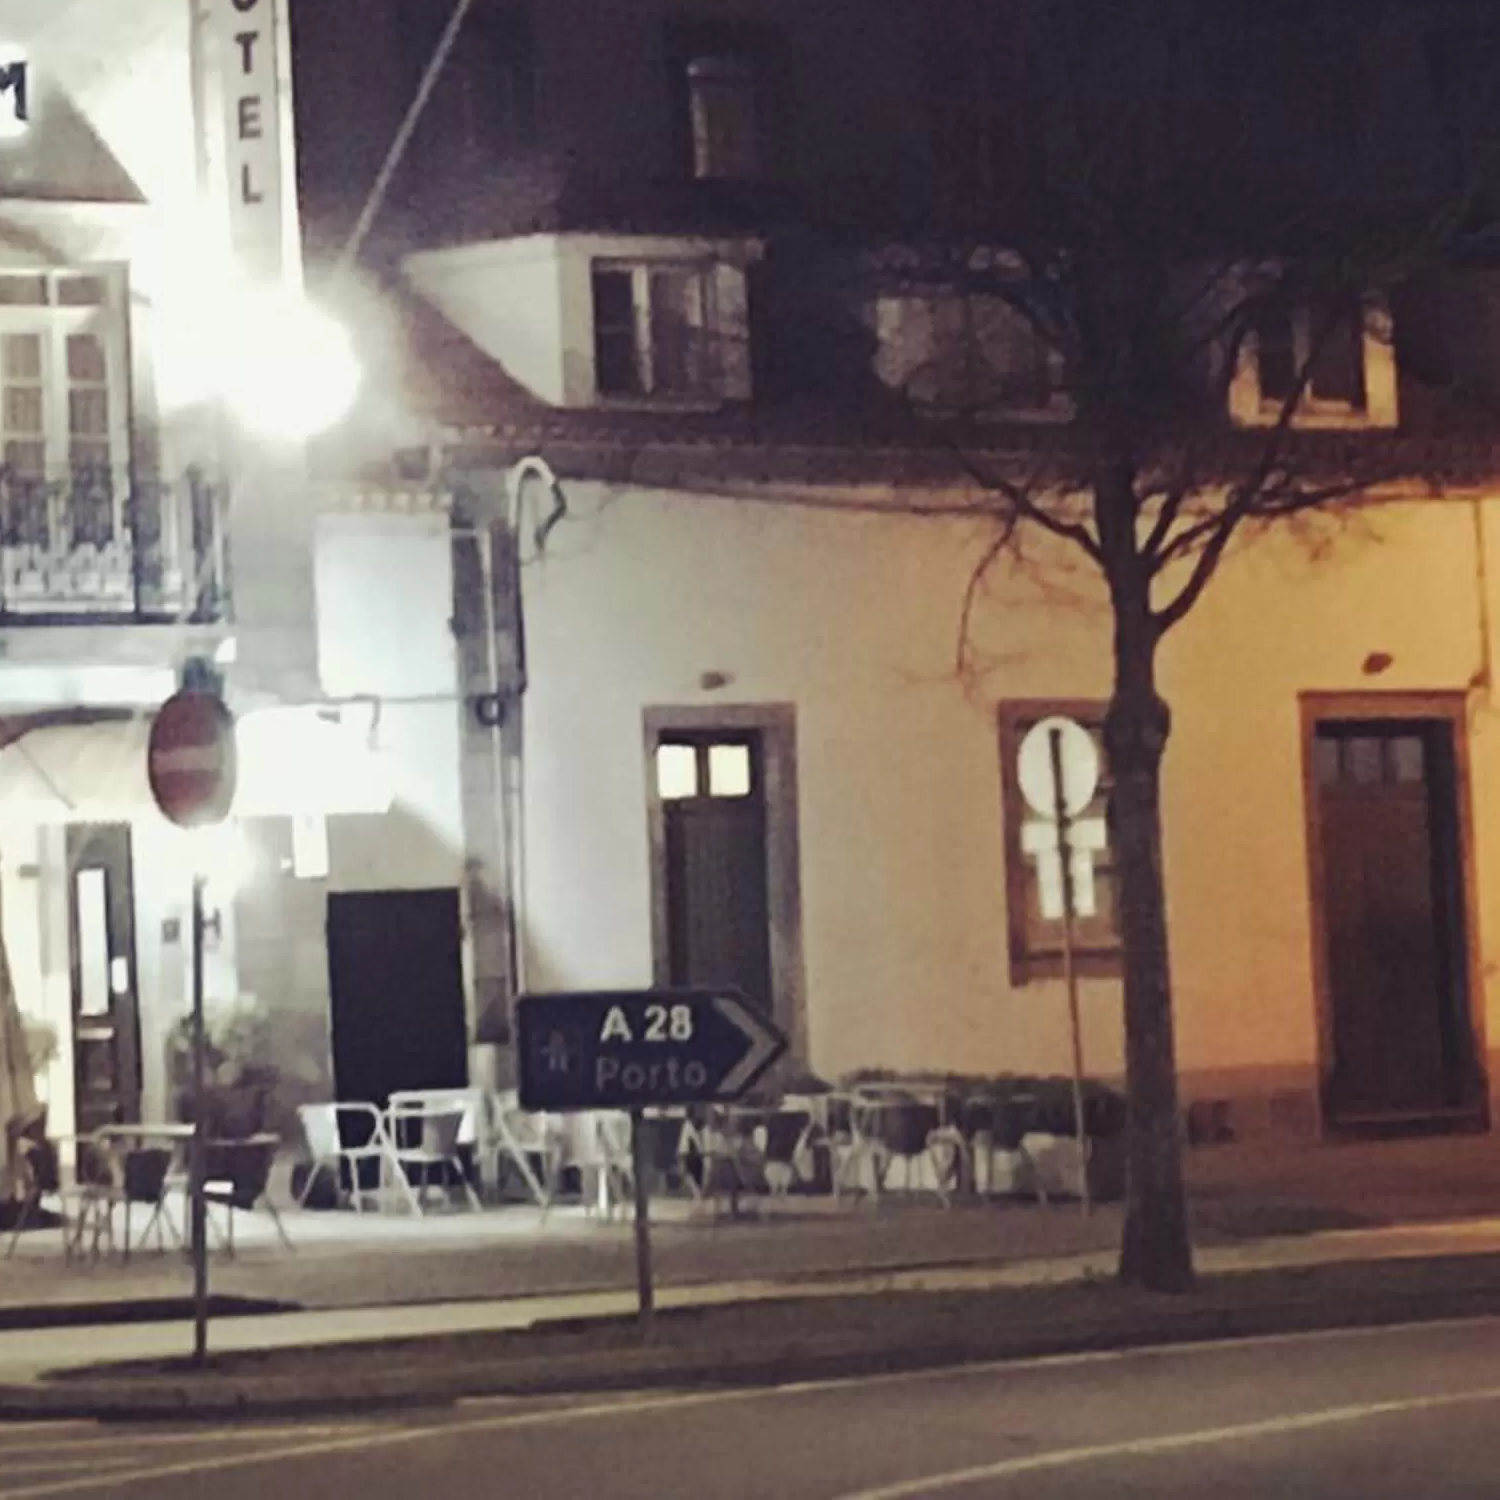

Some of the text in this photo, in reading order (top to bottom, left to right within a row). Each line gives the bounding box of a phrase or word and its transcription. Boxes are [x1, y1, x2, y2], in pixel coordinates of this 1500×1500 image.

[600, 1004, 694, 1042] A 28
[596, 1057, 708, 1092] Porto
